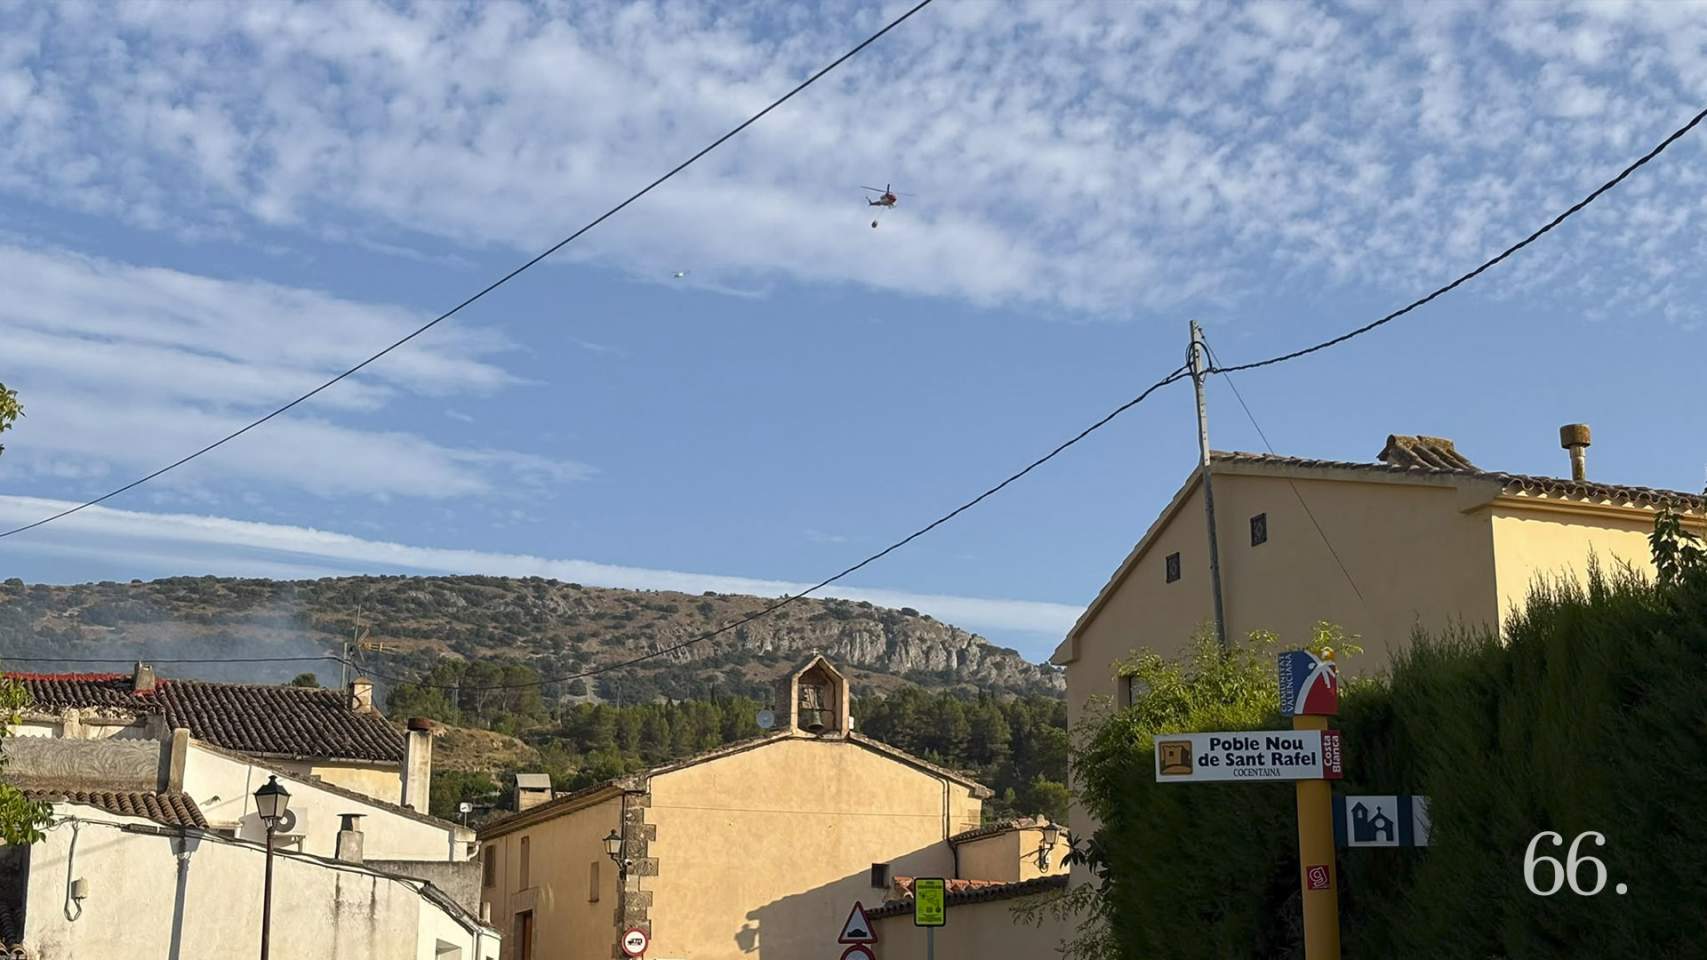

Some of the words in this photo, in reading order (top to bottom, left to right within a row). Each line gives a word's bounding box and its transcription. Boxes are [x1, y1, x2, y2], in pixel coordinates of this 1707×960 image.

[1285, 653, 1294, 712] VALENCIANA
[1209, 737, 1260, 751] Poble
[1265, 736, 1304, 750] Nou
[1323, 735, 1332, 767] Costa
[1332, 735, 1341, 773] Blanca
[1198, 753, 1220, 767] de
[1225, 752, 1265, 766] Sant
[1271, 752, 1316, 766] Rafel
[1233, 767, 1281, 777] COCENTAINA
